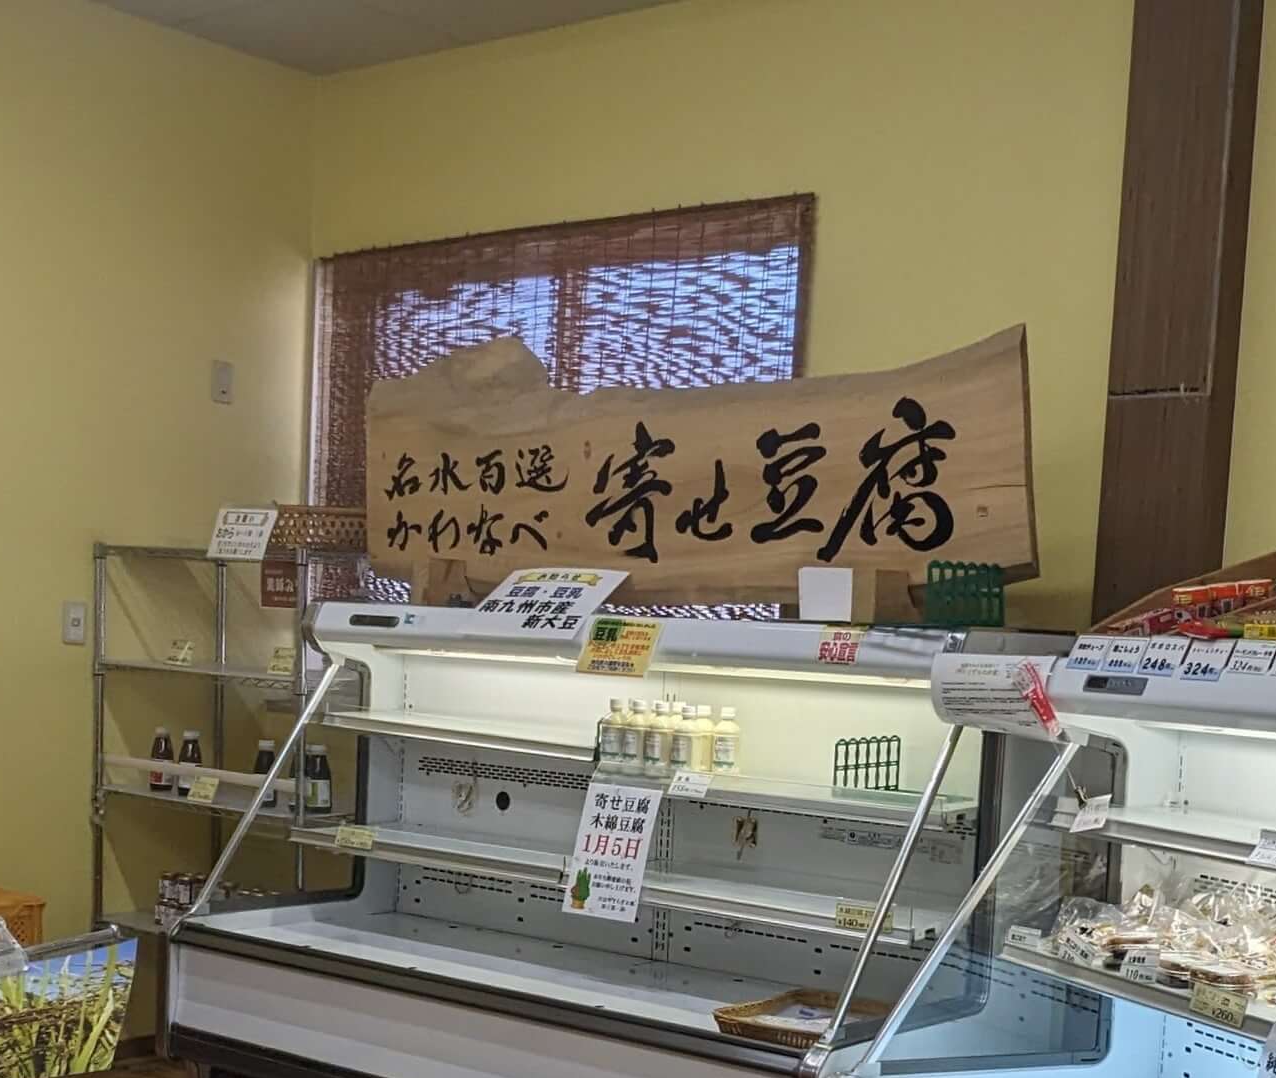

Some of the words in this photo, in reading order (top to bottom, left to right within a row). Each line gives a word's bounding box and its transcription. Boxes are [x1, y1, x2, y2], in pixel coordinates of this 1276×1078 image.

[385, 445, 568, 498] 名水百選
[585, 397, 956, 563] 寄せ豆腐
[385, 505, 549, 557] かわなべ
[506, 586, 584, 599] 豆腐・豆乳
[479, 599, 573, 615] 南九州市産
[521, 615, 582, 629] 新大豆
[595, 792, 651, 815] 寄せ豆腐
[591, 813, 646, 834] 木綿豆腐
[582, 834, 642, 860] 1月5日
